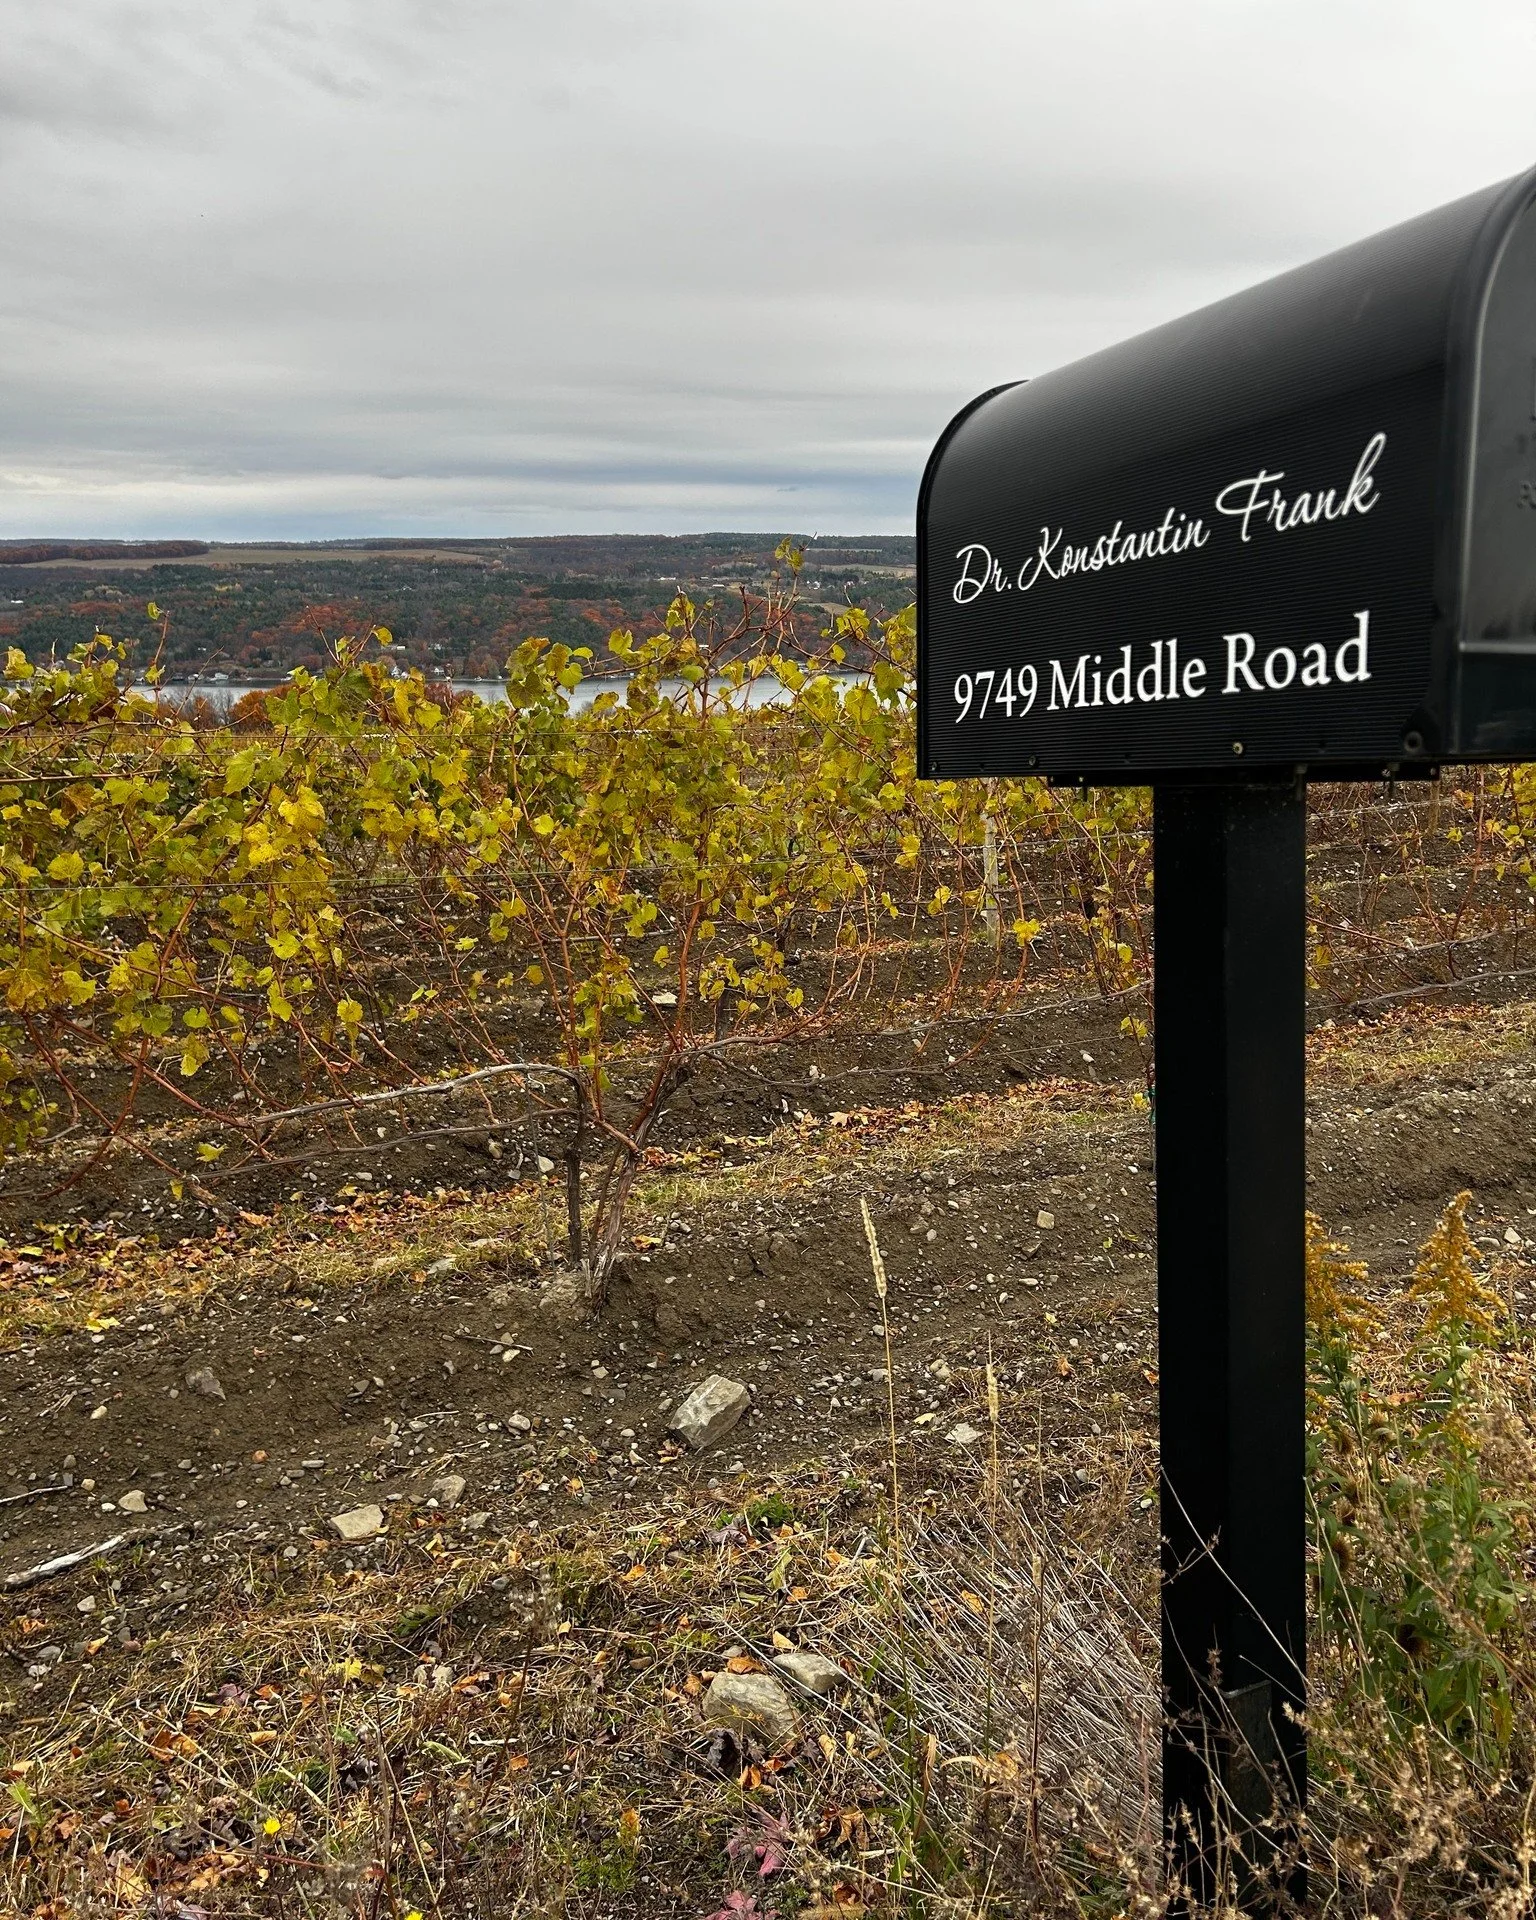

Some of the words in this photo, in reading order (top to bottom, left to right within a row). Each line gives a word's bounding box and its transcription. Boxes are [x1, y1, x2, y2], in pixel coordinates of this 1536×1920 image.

[953, 543, 1012, 604] Dr.
[1017, 507, 1211, 591] Konstantin
[1215, 432, 1386, 543] Frank
[953, 664, 1038, 724] 9749
[1046, 638, 1207, 711] Middle
[1221, 610, 1372, 694] Road
